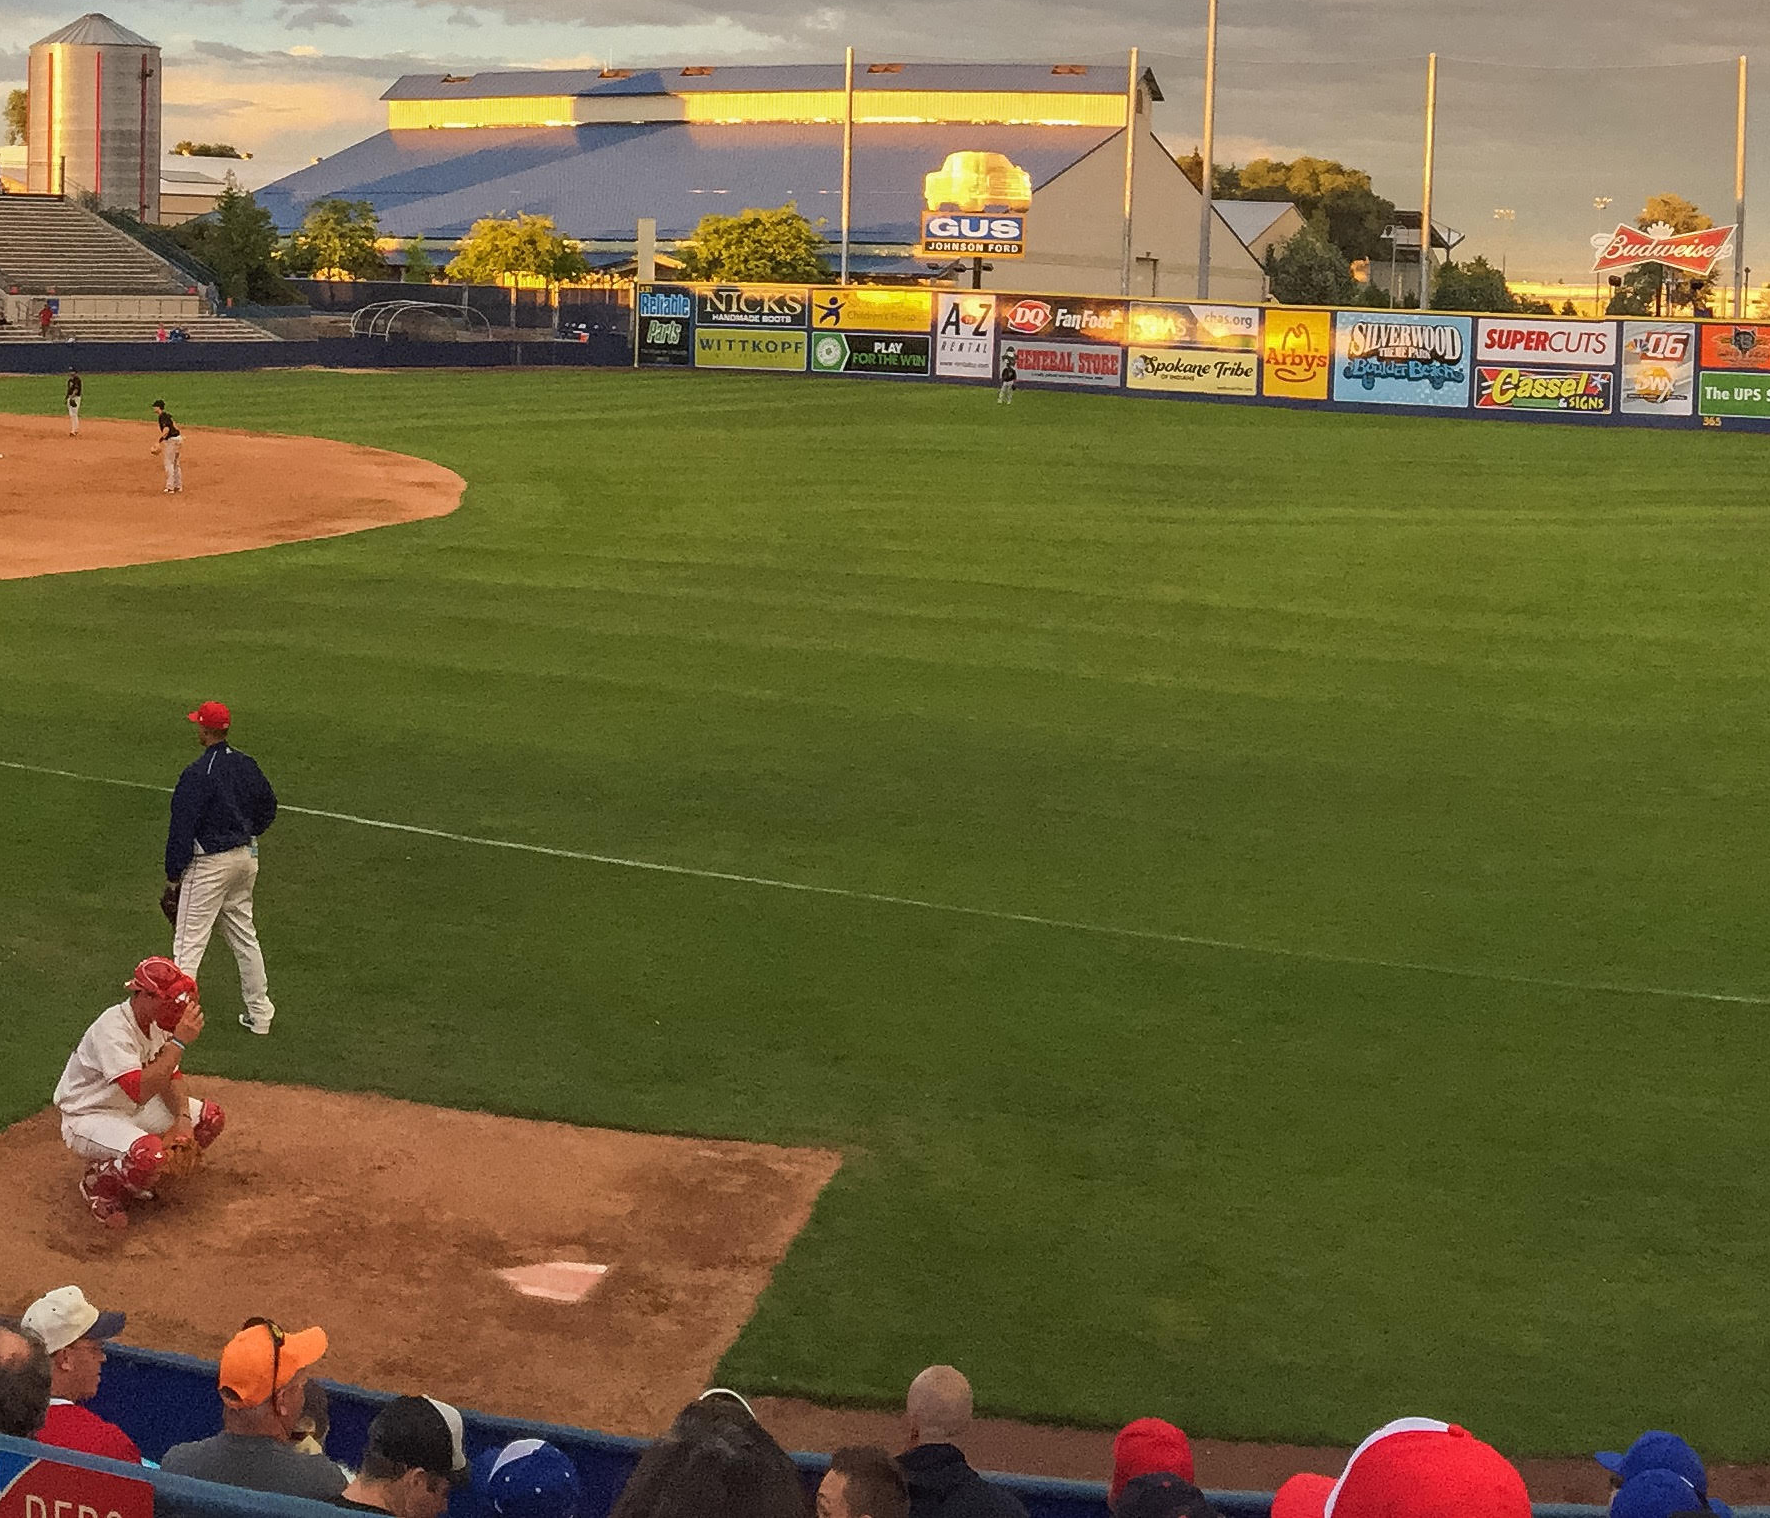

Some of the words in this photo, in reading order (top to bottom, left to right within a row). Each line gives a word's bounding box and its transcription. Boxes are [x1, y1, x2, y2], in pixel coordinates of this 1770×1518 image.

[929, 217, 1020, 239] GUS
[928, 242, 984, 252] JOHNSON
[988, 243, 1019, 253] FORD
[1590, 232, 1733, 260] Budweiser
[640, 293, 691, 318] Reliable
[704, 289, 803, 316] NICKS
[712, 313, 760, 323] HANDMADE
[762, 314, 792, 323] BOOTS
[1015, 307, 1045, 326] DQ
[1204, 311, 1253, 328] chas.org
[646, 319, 682, 345] Parts
[1350, 323, 1461, 360] SILVERWOOD
[1485, 329, 1607, 354] SUPERCUTS
[700, 338, 804, 355] WITTKOPF
[873, 342, 903, 354] PLAY
[941, 343, 988, 354] RENTAL
[1648, 333, 1687, 358] Q6
[852, 353, 874, 364] FOR
[875, 354, 899, 366] THE
[1078, 351, 1119, 375] STORE
[1145, 354, 1211, 377] Spokane
[1214, 359, 1254, 379] Tribe
[1266, 347, 1328, 372] Arby's
[1492, 368, 1589, 404] Cassel
[1705, 386, 1730, 400] The
[1734, 388, 1762, 402] UPS
[1559, 398, 1568, 408] &
[1569, 397, 1604, 410] SIGNS
